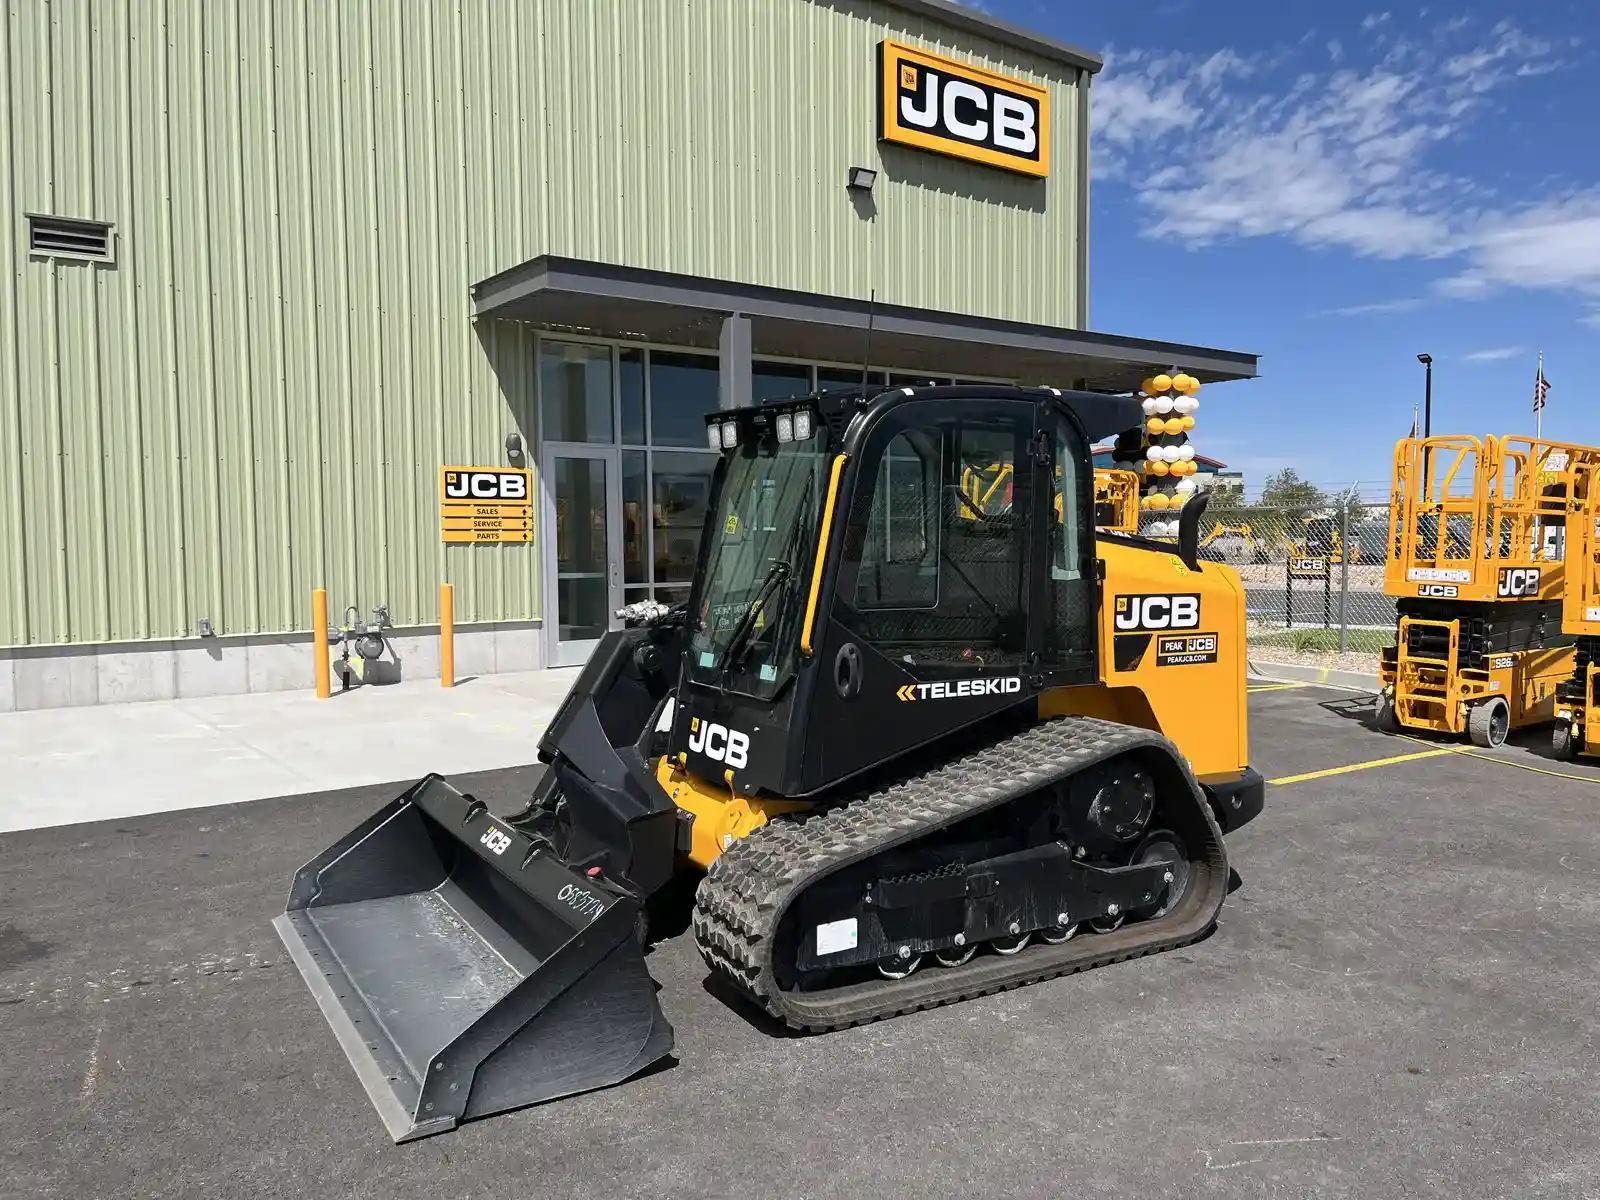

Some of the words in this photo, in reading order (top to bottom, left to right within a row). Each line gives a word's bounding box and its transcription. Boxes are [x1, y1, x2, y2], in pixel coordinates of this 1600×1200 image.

[900, 72, 1036, 153] JCB
[447, 473, 526, 498] JCB
[1293, 559, 1323, 570] JCB
[1418, 585, 1458, 597] JCB
[1498, 569, 1540, 596] JCB
[1116, 596, 1198, 629] JCB
[1165, 641, 1183, 651] PEAK
[1188, 638, 1214, 651] JCB
[1167, 655, 1207, 663] PEAKJCB.COM
[917, 677, 1021, 700] TELESKID
[688, 719, 750, 770] JCB
[479, 828, 513, 856] JCB
